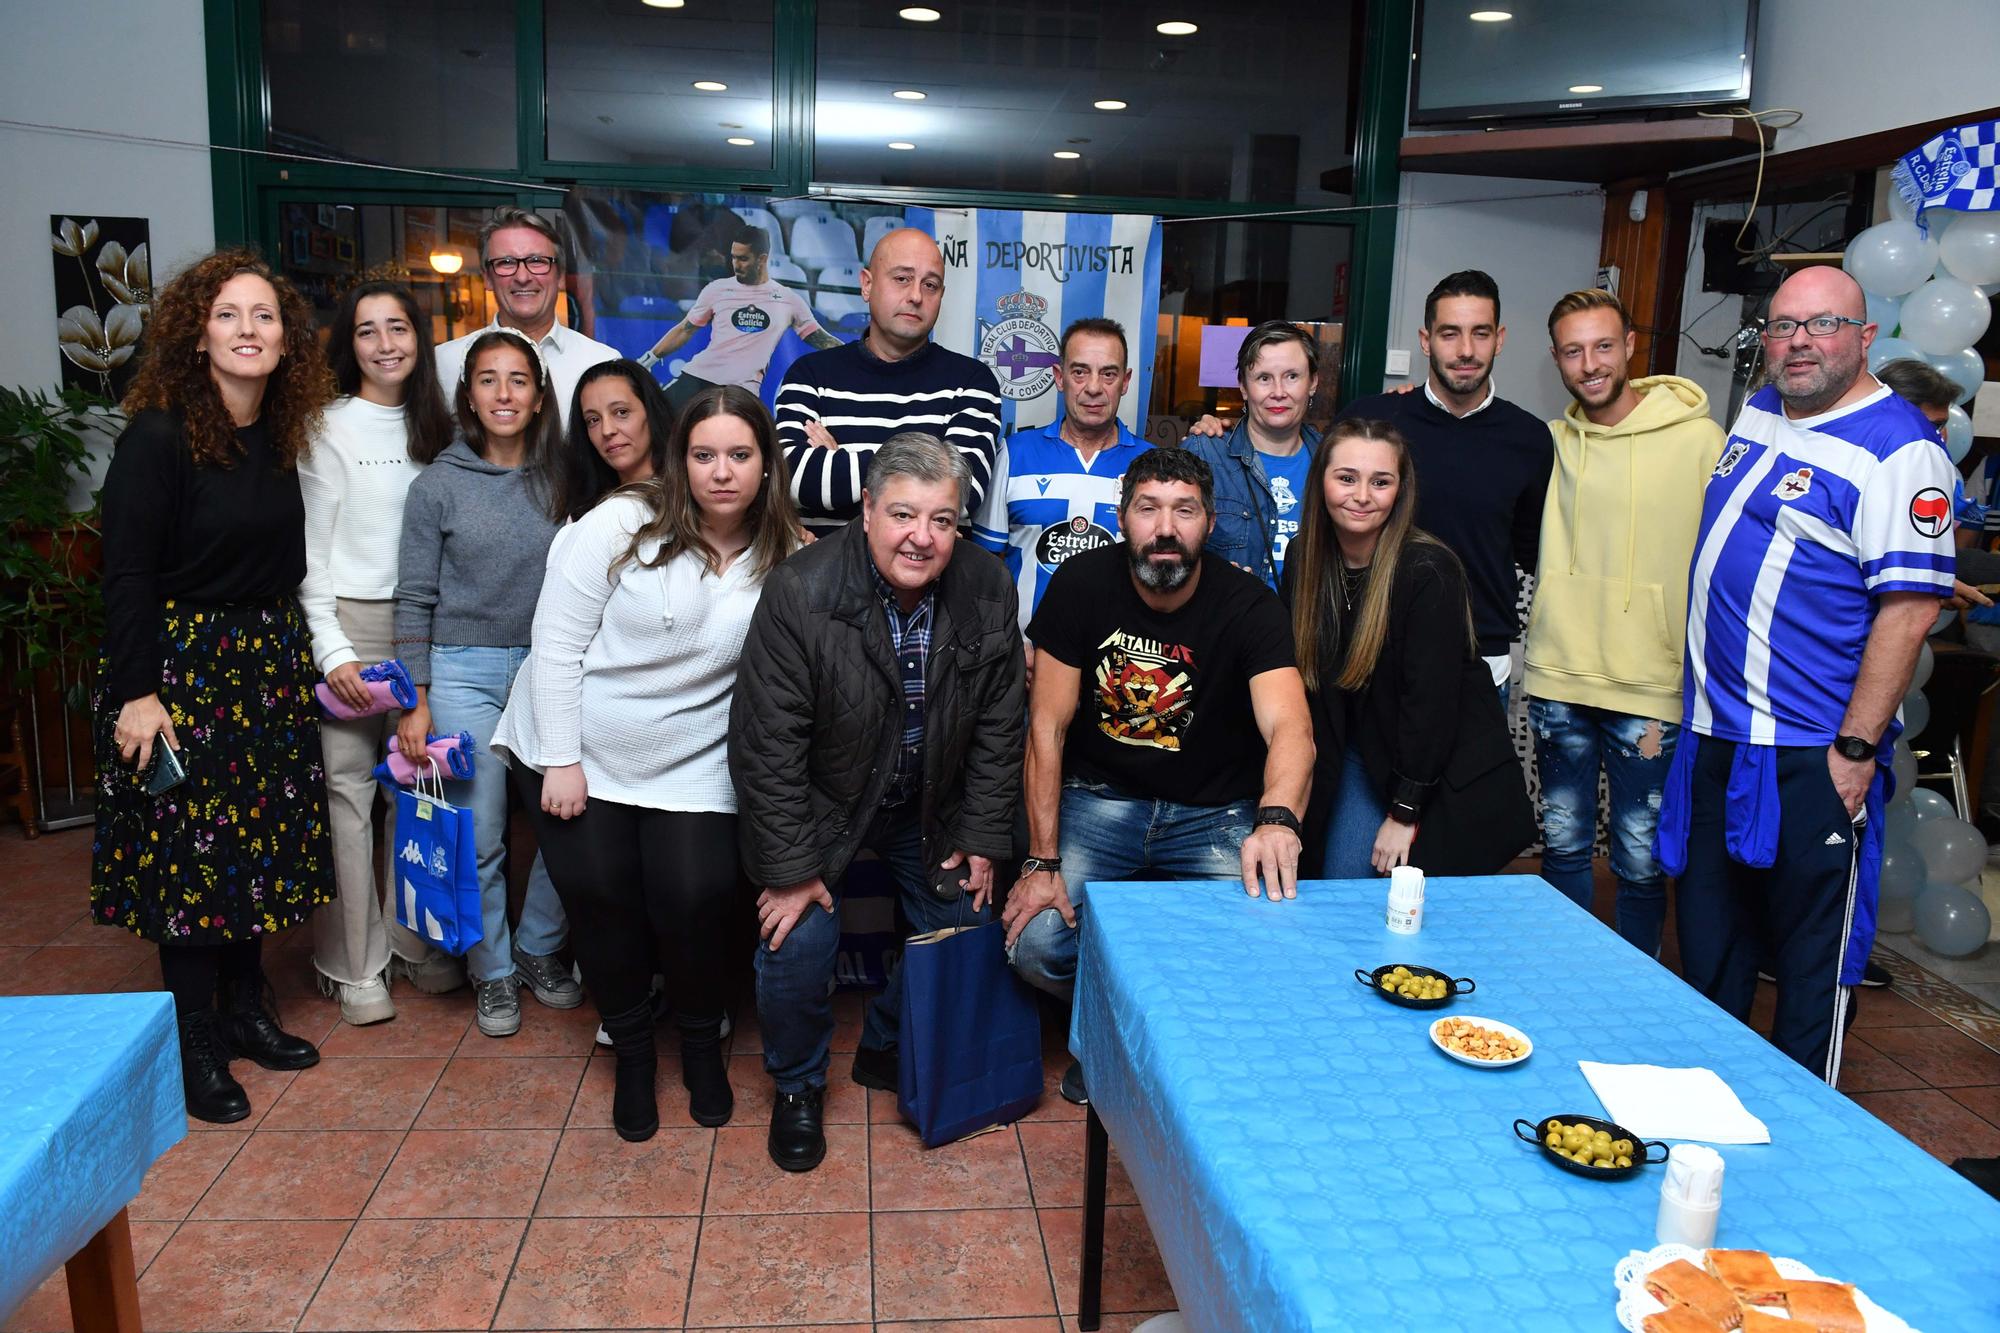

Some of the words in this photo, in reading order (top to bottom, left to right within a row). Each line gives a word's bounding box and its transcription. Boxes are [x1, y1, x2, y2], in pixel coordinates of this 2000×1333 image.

[936, 234, 969, 268] ÑA
[986, 241, 1134, 283] DEPORTIVISTA
[738, 312, 765, 320] Estrella
[984, 333, 999, 353] REAL
[996, 321, 1018, 336] CLUB
[1019, 320, 1056, 351] DEPORTIVO
[1003, 385, 1014, 396] LA
[1097, 627, 1200, 672] METALLICAT
